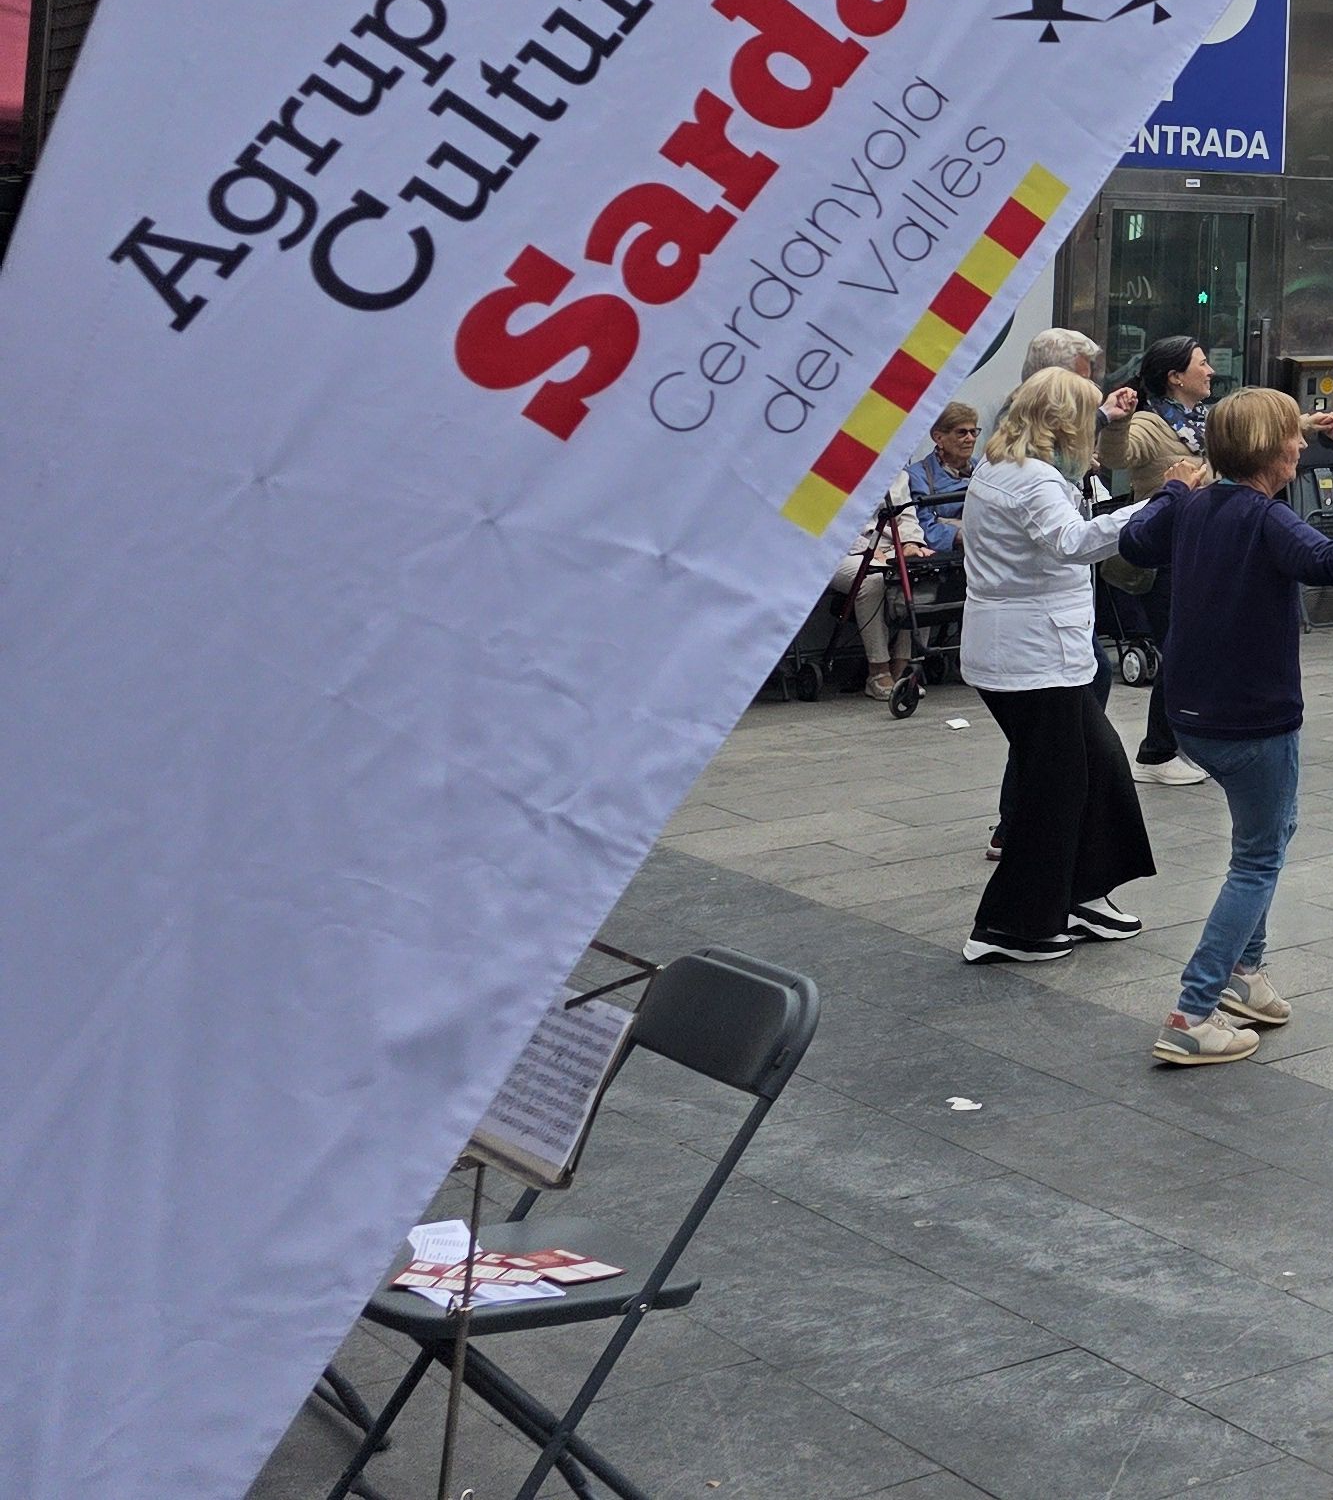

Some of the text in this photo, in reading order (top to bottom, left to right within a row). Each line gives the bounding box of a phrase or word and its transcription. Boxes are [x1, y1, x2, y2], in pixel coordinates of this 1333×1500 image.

[649, 75, 949, 432] Cerdanyola
[764, 126, 1006, 433] del Vallès
